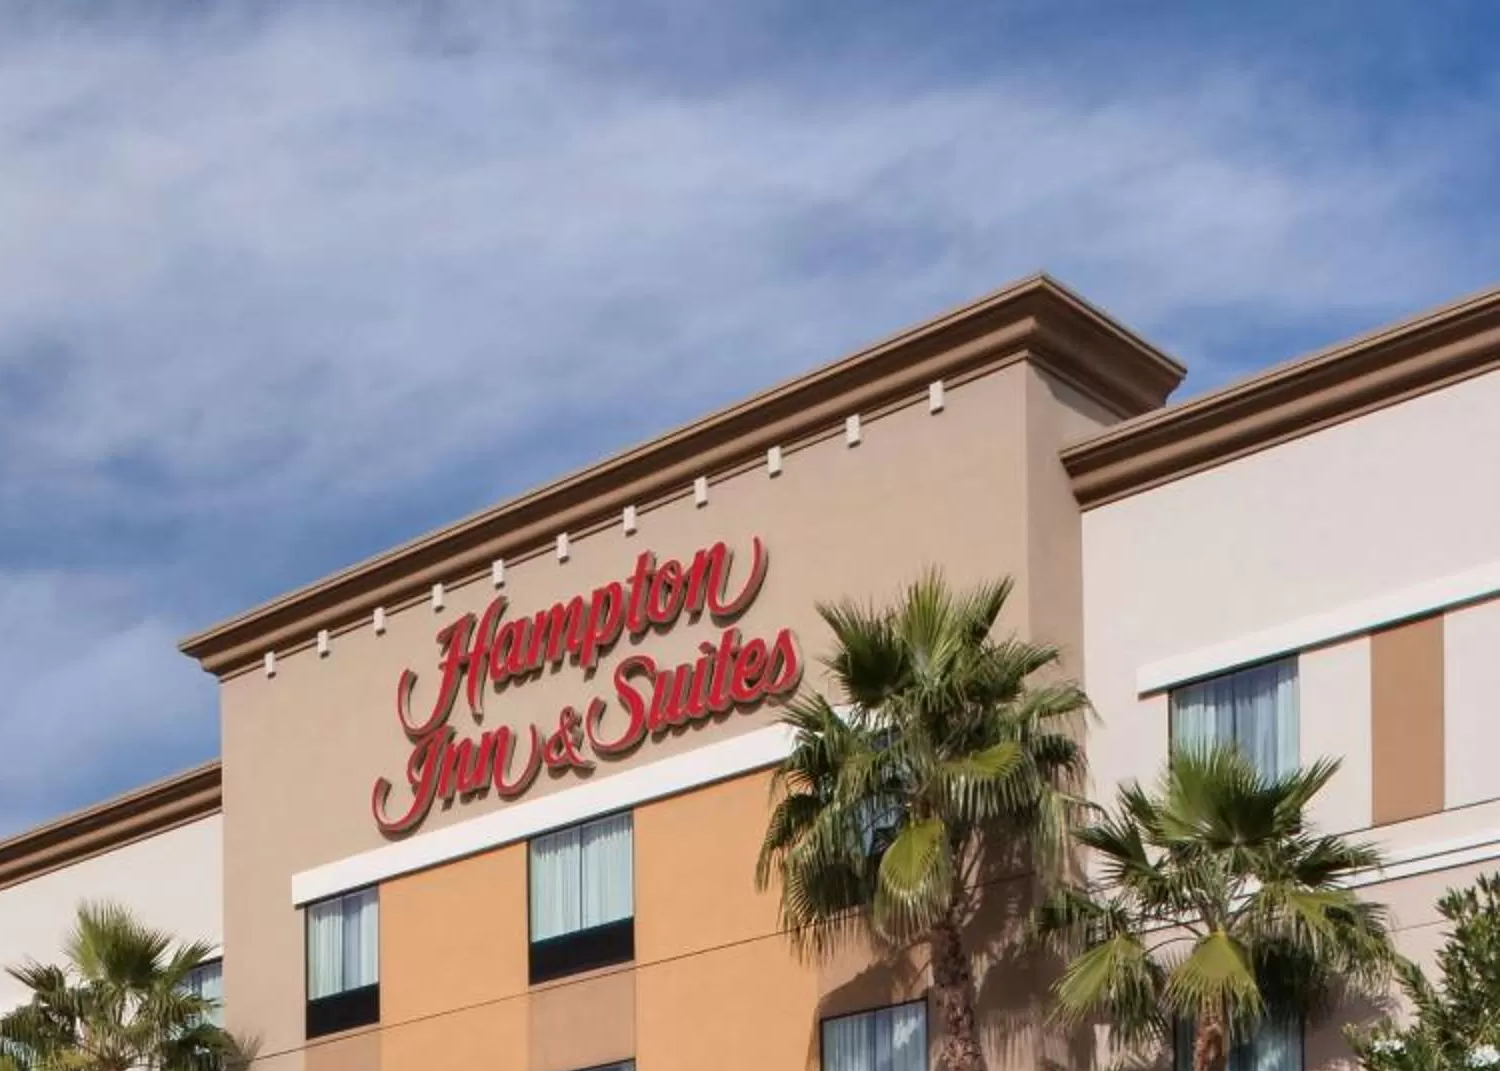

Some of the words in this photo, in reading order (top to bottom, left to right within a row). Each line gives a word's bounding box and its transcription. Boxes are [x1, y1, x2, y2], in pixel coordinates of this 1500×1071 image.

[372, 723, 542, 836] Inn
[543, 706, 596, 770] &
[586, 626, 803, 758] Suites
[397, 536, 768, 736] Hampton
